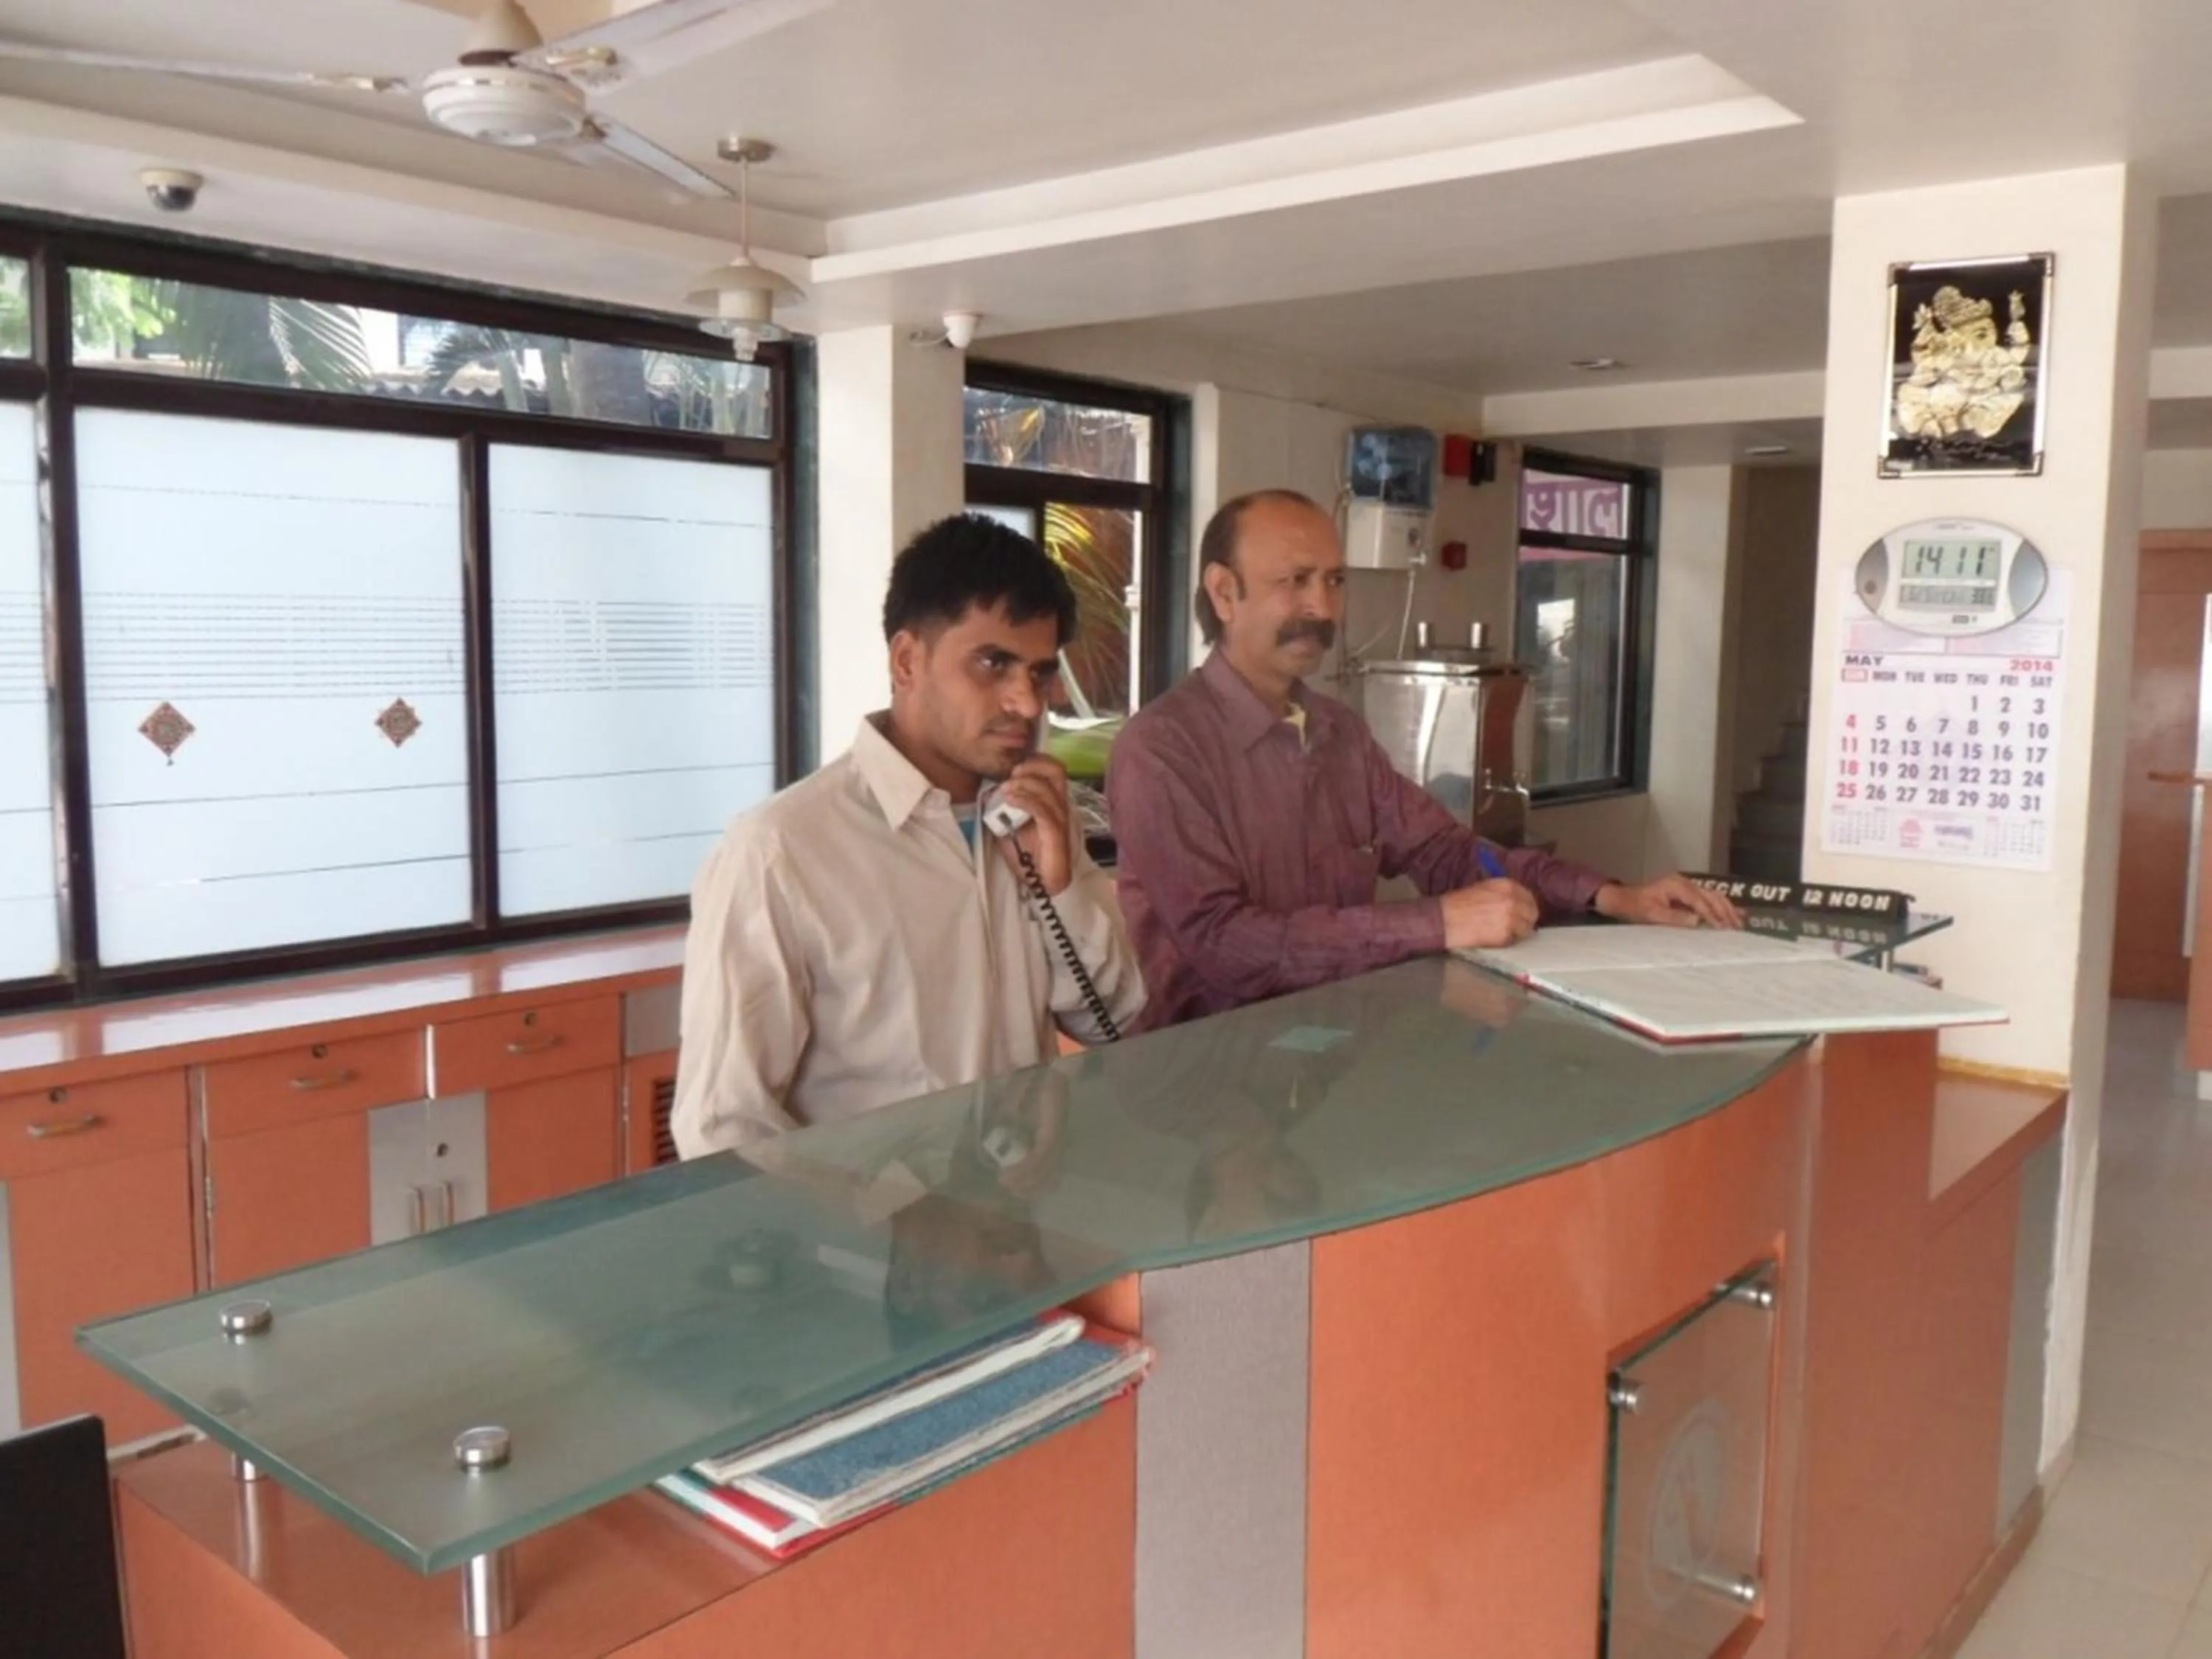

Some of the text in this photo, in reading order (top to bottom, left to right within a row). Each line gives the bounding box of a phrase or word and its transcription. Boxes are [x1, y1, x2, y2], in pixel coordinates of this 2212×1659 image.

[1845, 655, 1883, 666] MAY
[2010, 658, 2053, 672] 2014
[1971, 695, 2045, 715] 1 2 3
[1846, 713, 2050, 740] 4 5 6 7 8 9 10
[1840, 736, 2048, 764] 11 12 13 14 15 16 17
[1840, 759, 2045, 787] 18 19 20 21 22 23 24
[1836, 782, 2041, 813] 25 26 27 28 29 30 31
[1750, 883, 1791, 902] OUT
[1802, 888, 1823, 905] 12
[1828, 891, 1891, 911] NOON
